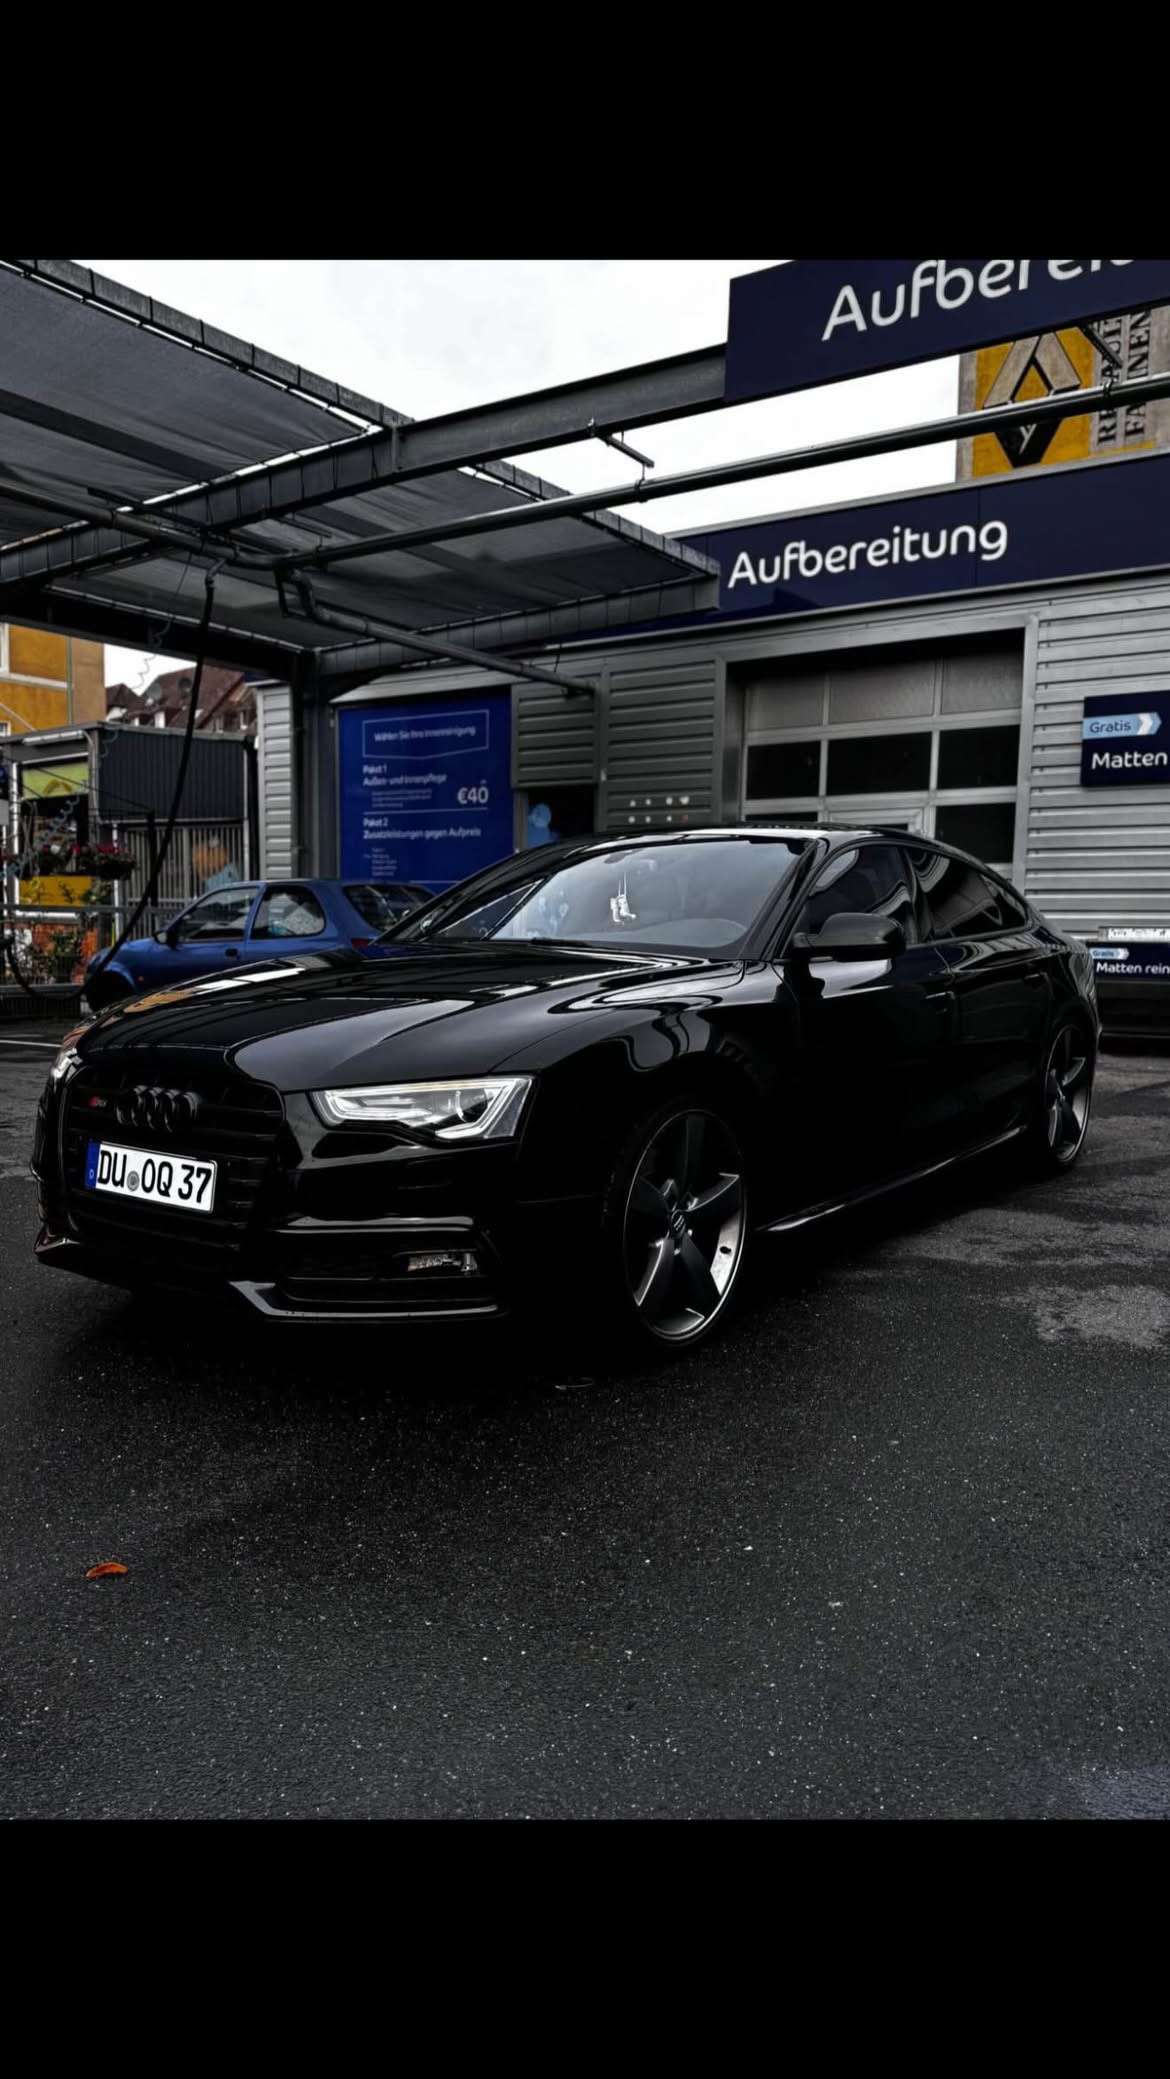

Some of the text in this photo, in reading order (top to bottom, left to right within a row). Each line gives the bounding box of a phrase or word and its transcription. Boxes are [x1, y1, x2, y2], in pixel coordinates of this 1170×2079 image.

[727, 519, 1009, 589] Aufbereitung
[1089, 718, 1132, 734] Gratis
[1091, 750, 1169, 770] Matten
[457, 786, 489, 804] €40
[1096, 961, 1142, 974] Matten
[97, 1149, 213, 1204] DU OQ 37
